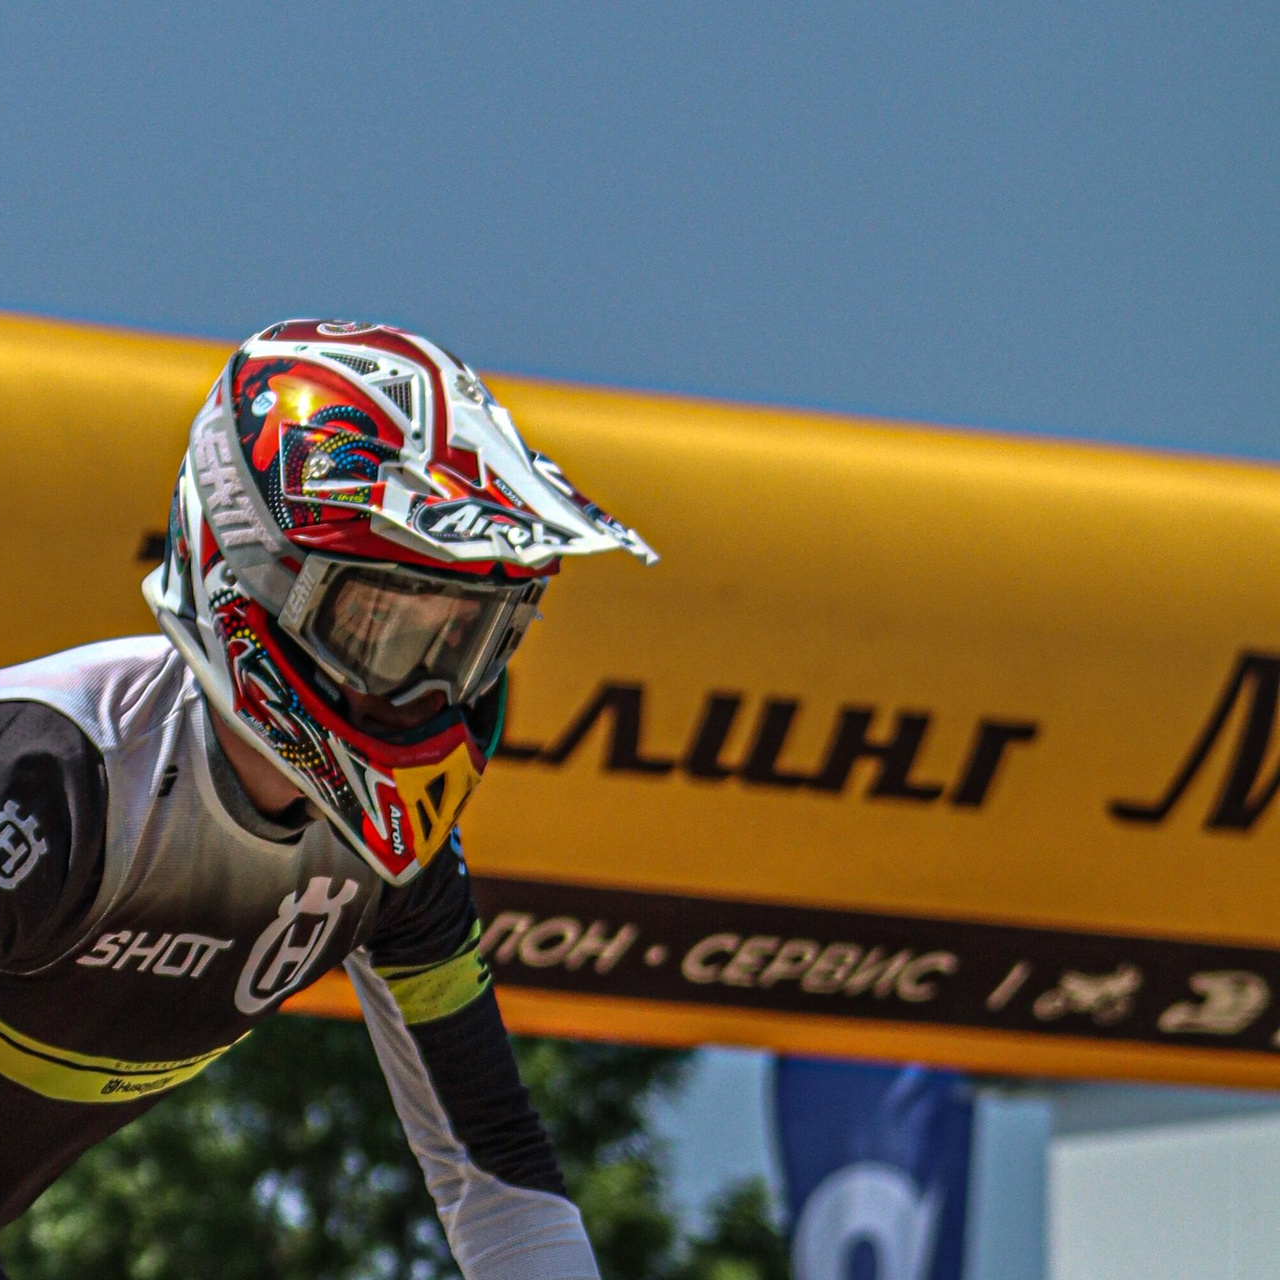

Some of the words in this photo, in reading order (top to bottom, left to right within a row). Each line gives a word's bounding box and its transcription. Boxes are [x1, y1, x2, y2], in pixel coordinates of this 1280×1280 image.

[495, 680, 1038, 808] ЛИНГ
[389, 803, 405, 856] Airoh
[76, 930, 236, 979] SHOT
[682, 934, 960, 1001] СЕРВИС
